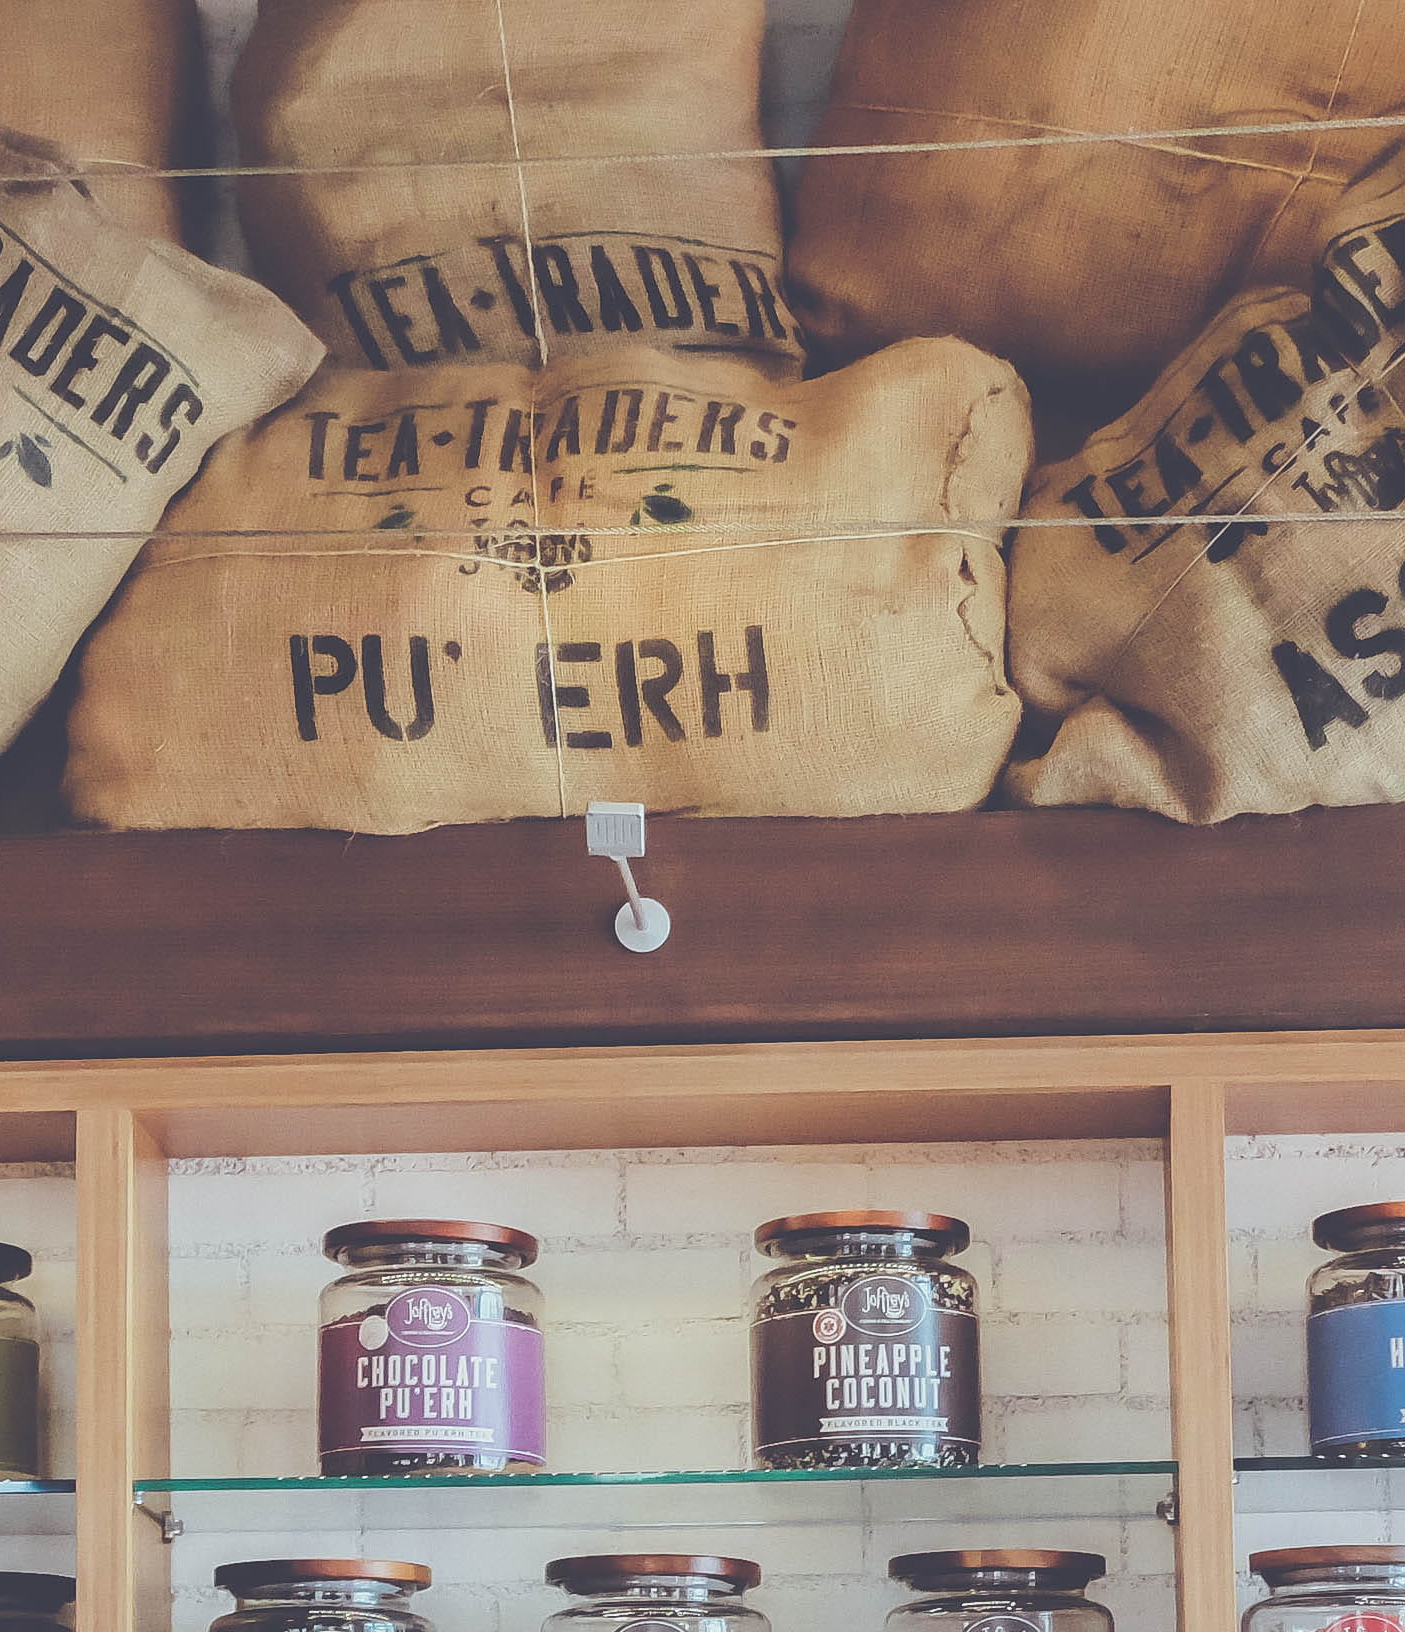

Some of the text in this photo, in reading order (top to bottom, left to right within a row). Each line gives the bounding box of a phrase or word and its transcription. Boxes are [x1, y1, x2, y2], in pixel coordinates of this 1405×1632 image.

[535, 624, 771, 749] ERH
[356, 1354, 498, 1390] CHOCOLATE
[811, 1343, 951, 1380] PINEAPPLE
[825, 1375, 941, 1411] COCONUT
